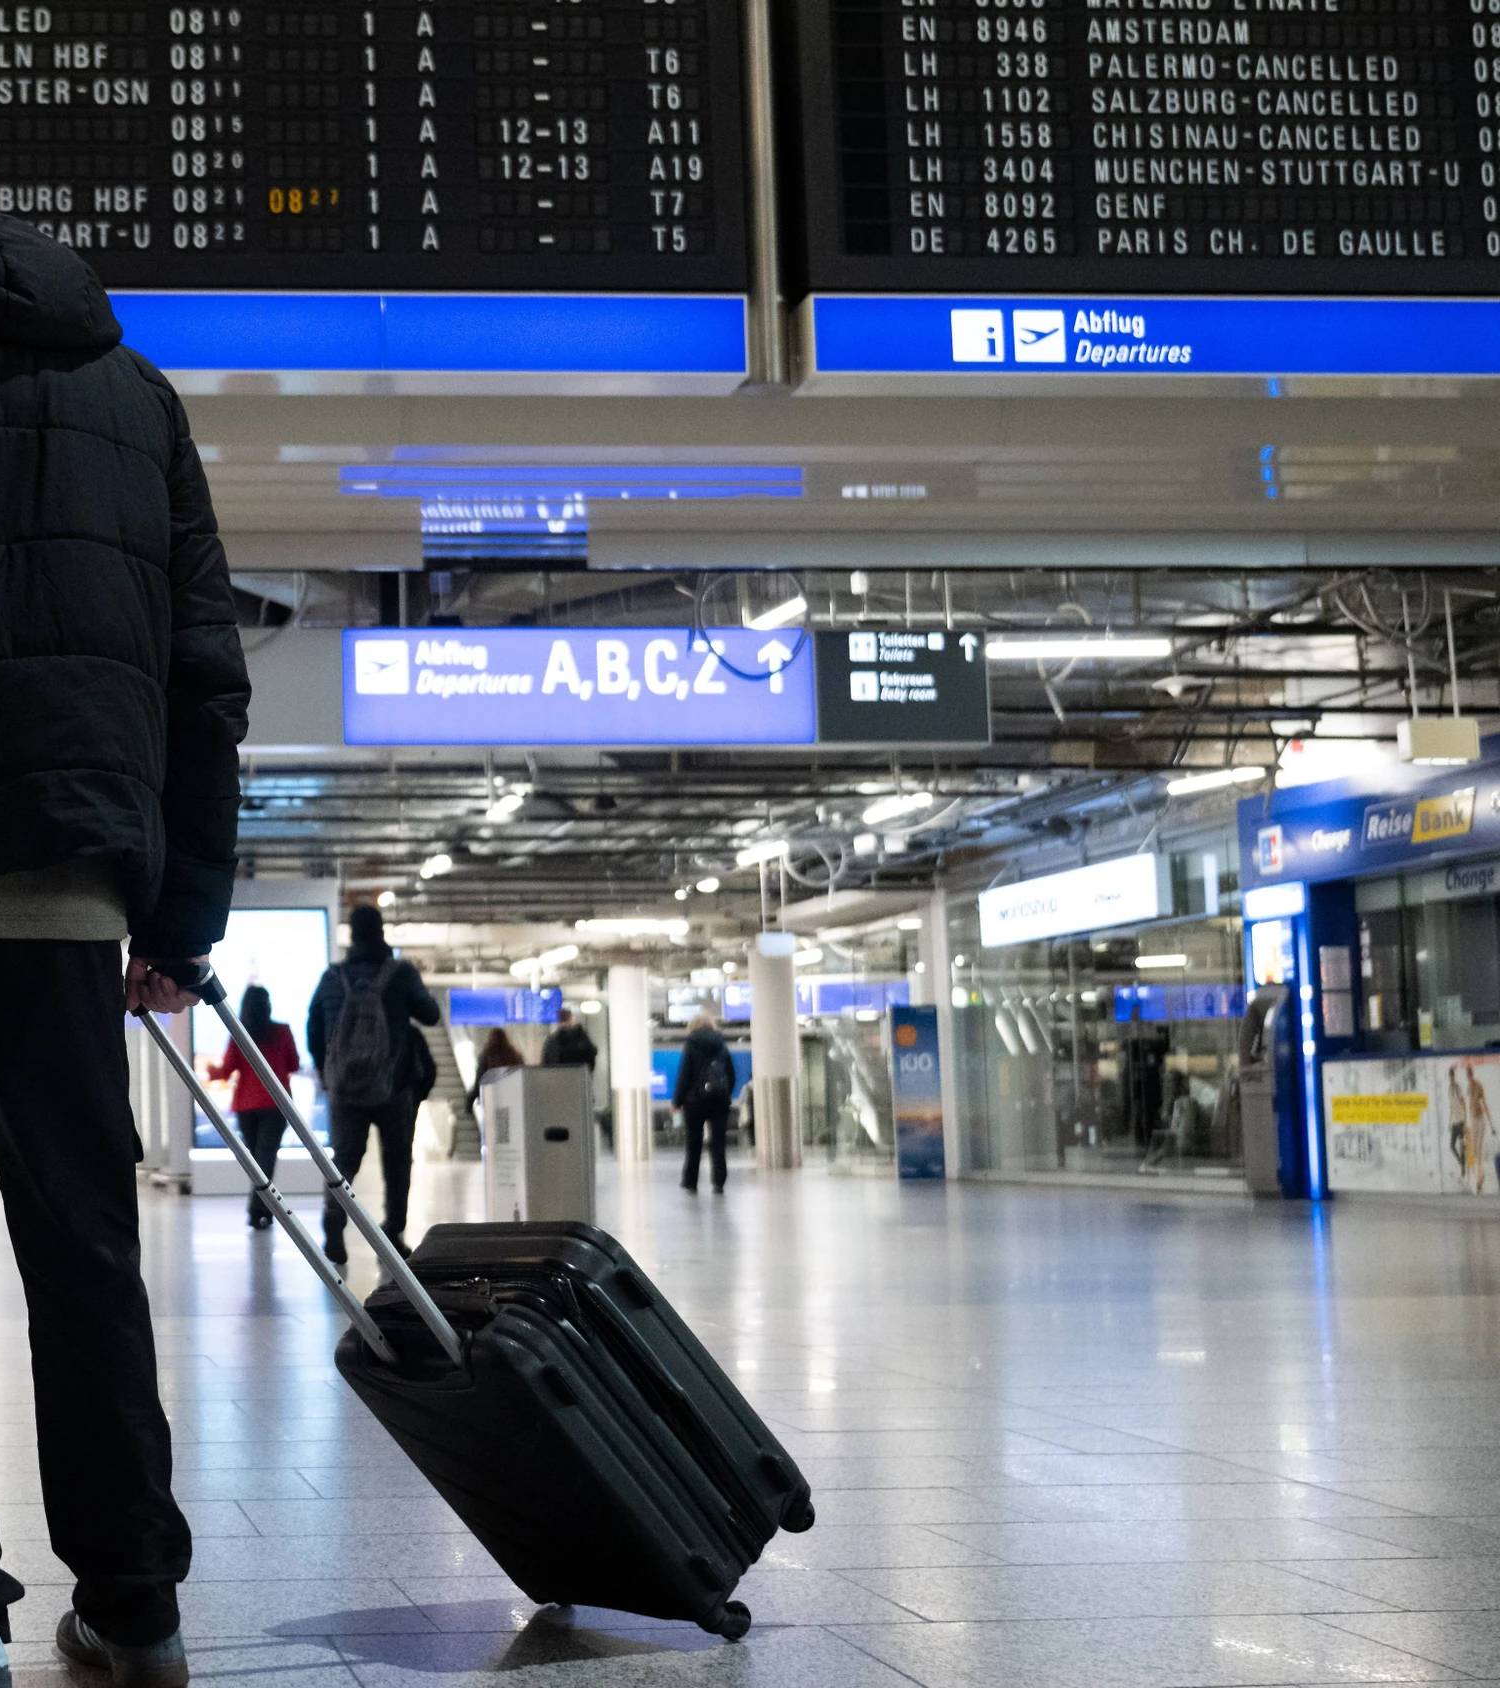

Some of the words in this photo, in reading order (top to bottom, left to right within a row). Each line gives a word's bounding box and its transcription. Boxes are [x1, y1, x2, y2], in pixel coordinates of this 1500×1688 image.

[169, 8, 241, 35] 0810
[363, 11, 374, 36] 1
[416, 11, 434, 37] A
[901, 16, 936, 42] EN
[976, 17, 1047, 43] 8946
[1087, 18, 1250, 45] AMSTERDAM
[54, 42, 107, 69] HBF
[170, 44, 240, 71] 0811
[364, 46, 375, 72] 1
[417, 46, 435, 72] A
[646, 48, 680, 75] T6
[903, 52, 938, 77] LH
[996, 51, 1049, 78] 338
[1088, 52, 1398, 82] PALERMO-CANCELLED
[170, 79, 241, 106] 0811
[365, 81, 376, 107] 1
[418, 82, 436, 107] A
[647, 83, 681, 110] T6
[905, 86, 939, 112] LH
[982, 87, 1050, 113] 1102
[1091, 87, 1418, 117] SALZBURG-CANCELLED
[171, 115, 243, 142] 0815
[366, 117, 377, 143] 1
[419, 117, 436, 143] A
[500, 118, 588, 145] 12-13
[647, 119, 699, 145] A11
[906, 122, 941, 147] LH
[984, 122, 1052, 149] 1558
[1092, 122, 1421, 152] CHISINAU-CANCELLED
[1478, 126, 1500, 153] 0
[171, 151, 244, 178] 0820
[367, 153, 378, 178] 1
[420, 153, 438, 178] A
[501, 153, 589, 181] 12-13
[649, 155, 703, 181] A19
[908, 157, 942, 183] LH
[983, 157, 1054, 184] 3404
[1094, 158, 1460, 187] MUENCHEN-STUTTGART-U
[94, 186, 147, 213] HBF
[172, 186, 243, 214] 0821
[368, 189, 379, 214] 1
[421, 189, 439, 214] A
[650, 190, 684, 216] T7
[910, 191, 945, 218] EN
[984, 192, 1055, 219] 8092
[1095, 192, 1165, 219] GENF
[173, 222, 244, 249] 0822
[368, 224, 379, 250] 1
[422, 224, 439, 250] A
[651, 225, 687, 253] T5
[910, 227, 944, 253] DE
[986, 227, 1057, 254] 4265
[1097, 228, 1188, 255] PARIS
[1209, 228, 1257, 255] CH.
[1282, 229, 1316, 256] DE
[1338, 229, 1445, 257] GAULLE
[1073, 310, 1145, 338] Abflug
[1075, 340, 1192, 367] Departures
[414, 641, 487, 669] Abflug
[878, 632, 927, 648] Toiletten
[415, 671, 532, 697] Departures
[909, 688, 937, 702] room
[1367, 808, 1412, 840] Reise
[1420, 800, 1465, 833] Bank
[1445, 866, 1495, 892] Change
